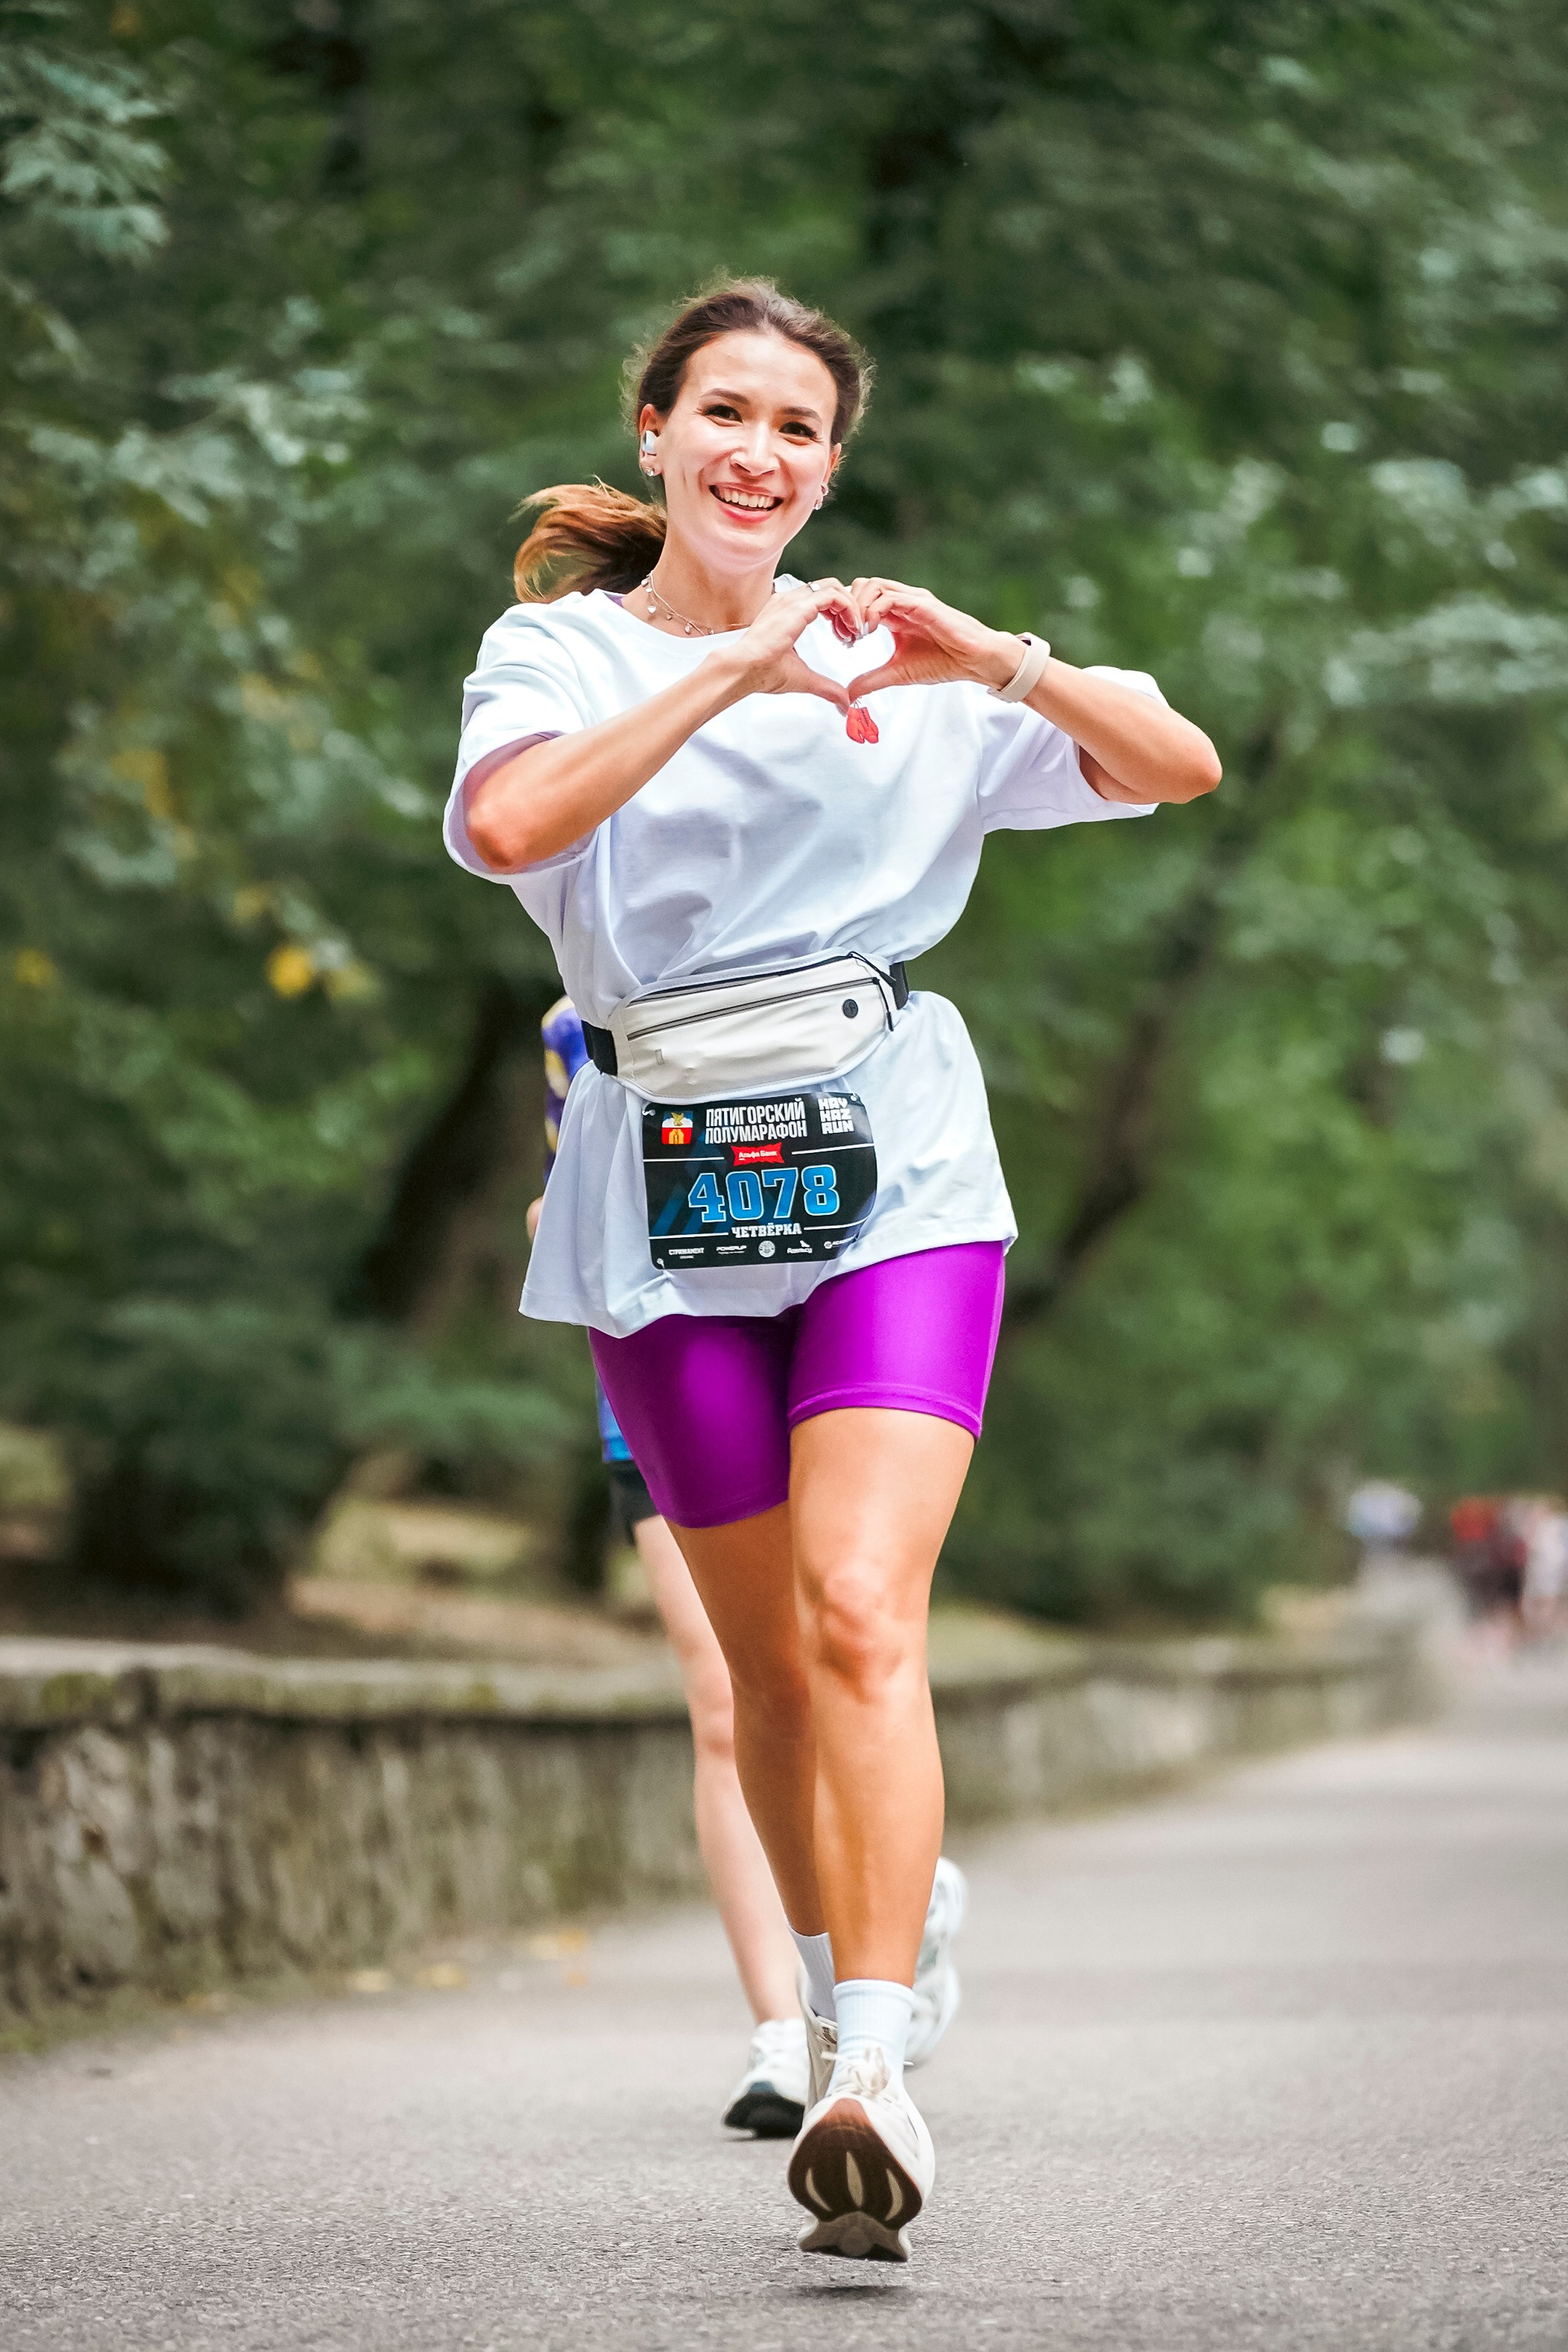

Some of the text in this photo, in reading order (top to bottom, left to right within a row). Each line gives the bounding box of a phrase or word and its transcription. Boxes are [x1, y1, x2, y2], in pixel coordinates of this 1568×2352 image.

[705, 1098, 805, 1127] ПЯТИГОРСКИЙ
[705, 1120, 807, 1144] ПОЛУМАРАФОН
[821, 1119, 854, 1134] RUN
[688, 1164, 840, 1223] 4078
[731, 1223, 802, 1238] ЧЕТВЁРКА
